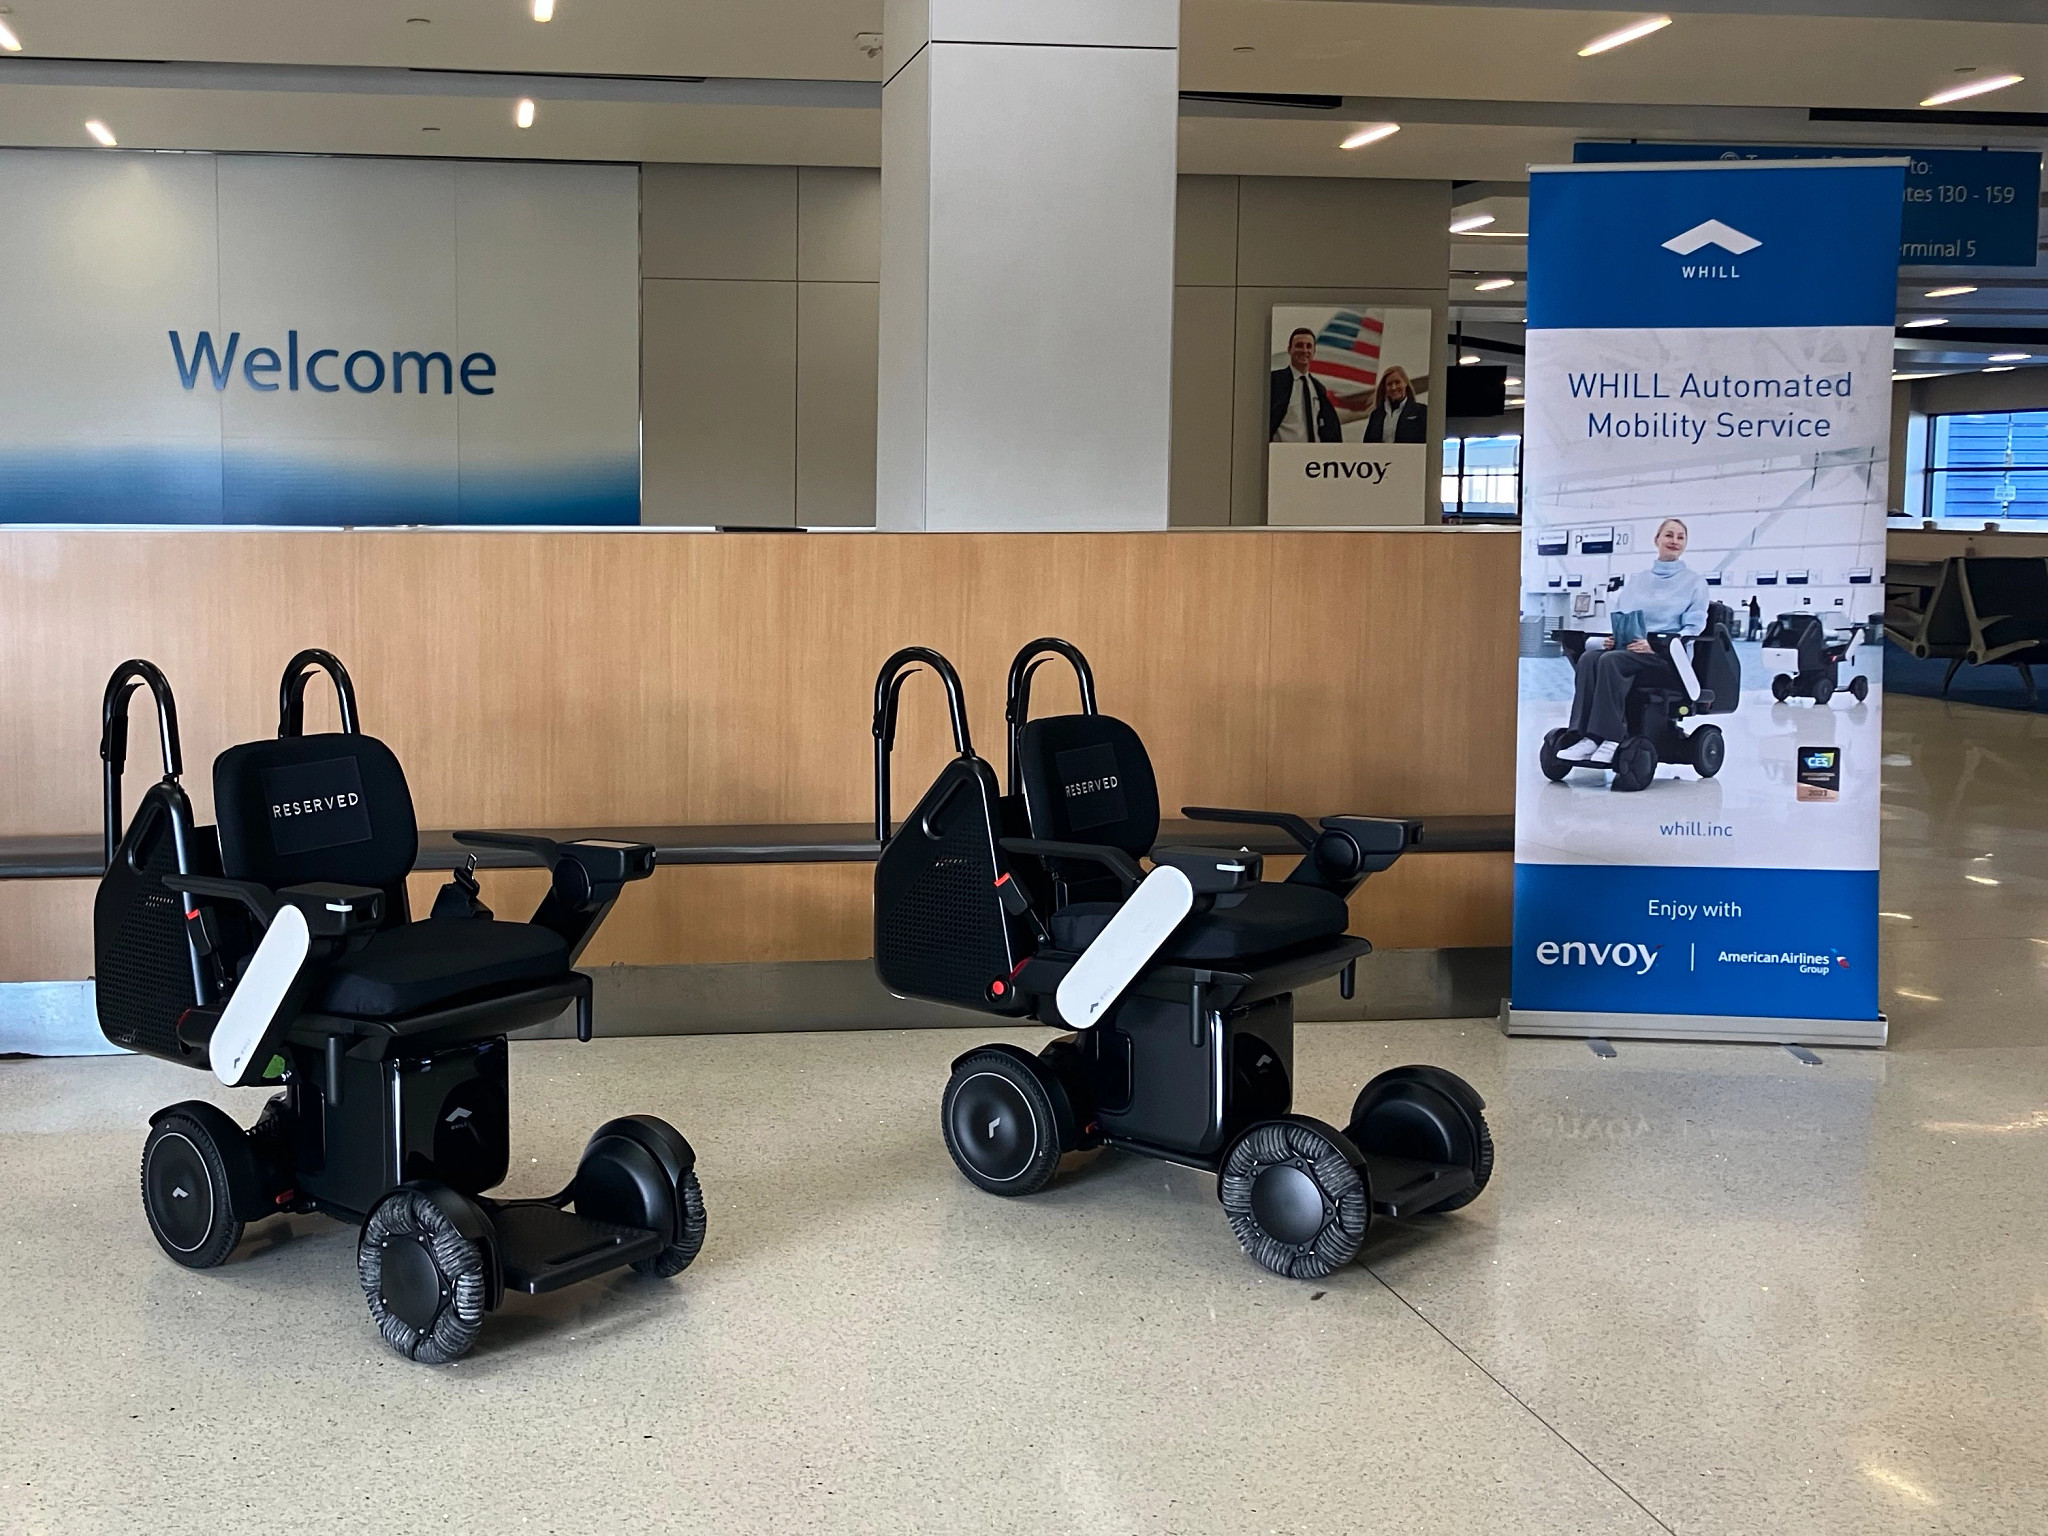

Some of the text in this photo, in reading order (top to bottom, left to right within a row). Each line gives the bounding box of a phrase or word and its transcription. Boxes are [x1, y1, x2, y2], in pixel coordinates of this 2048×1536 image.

[1910, 160, 1933, 175] to:
[1902, 187, 1933, 203] tes
[1937, 185, 1968, 203] 130
[1985, 186, 2016, 204] 159
[1900, 239, 1977, 257] rminal 5
[1681, 265, 1740, 279] WHILL
[168, 329, 497, 395] Welcome
[1568, 371, 1852, 399] WHILL Automated
[1587, 411, 1831, 445] Mobility Service
[1305, 461, 1391, 485] envoy
[1615, 532, 1629, 546] 20
[1807, 756, 1828, 767] CES
[1065, 776, 1118, 797] RESERVED
[272, 792, 359, 818] RESERVED
[1660, 821, 1734, 837] whill.inc
[1648, 899, 1742, 921] Enjoy with
[1536, 941, 1659, 975] envoy
[1718, 950, 1830, 965] American Airlines
[1799, 964, 1830, 976] Group
